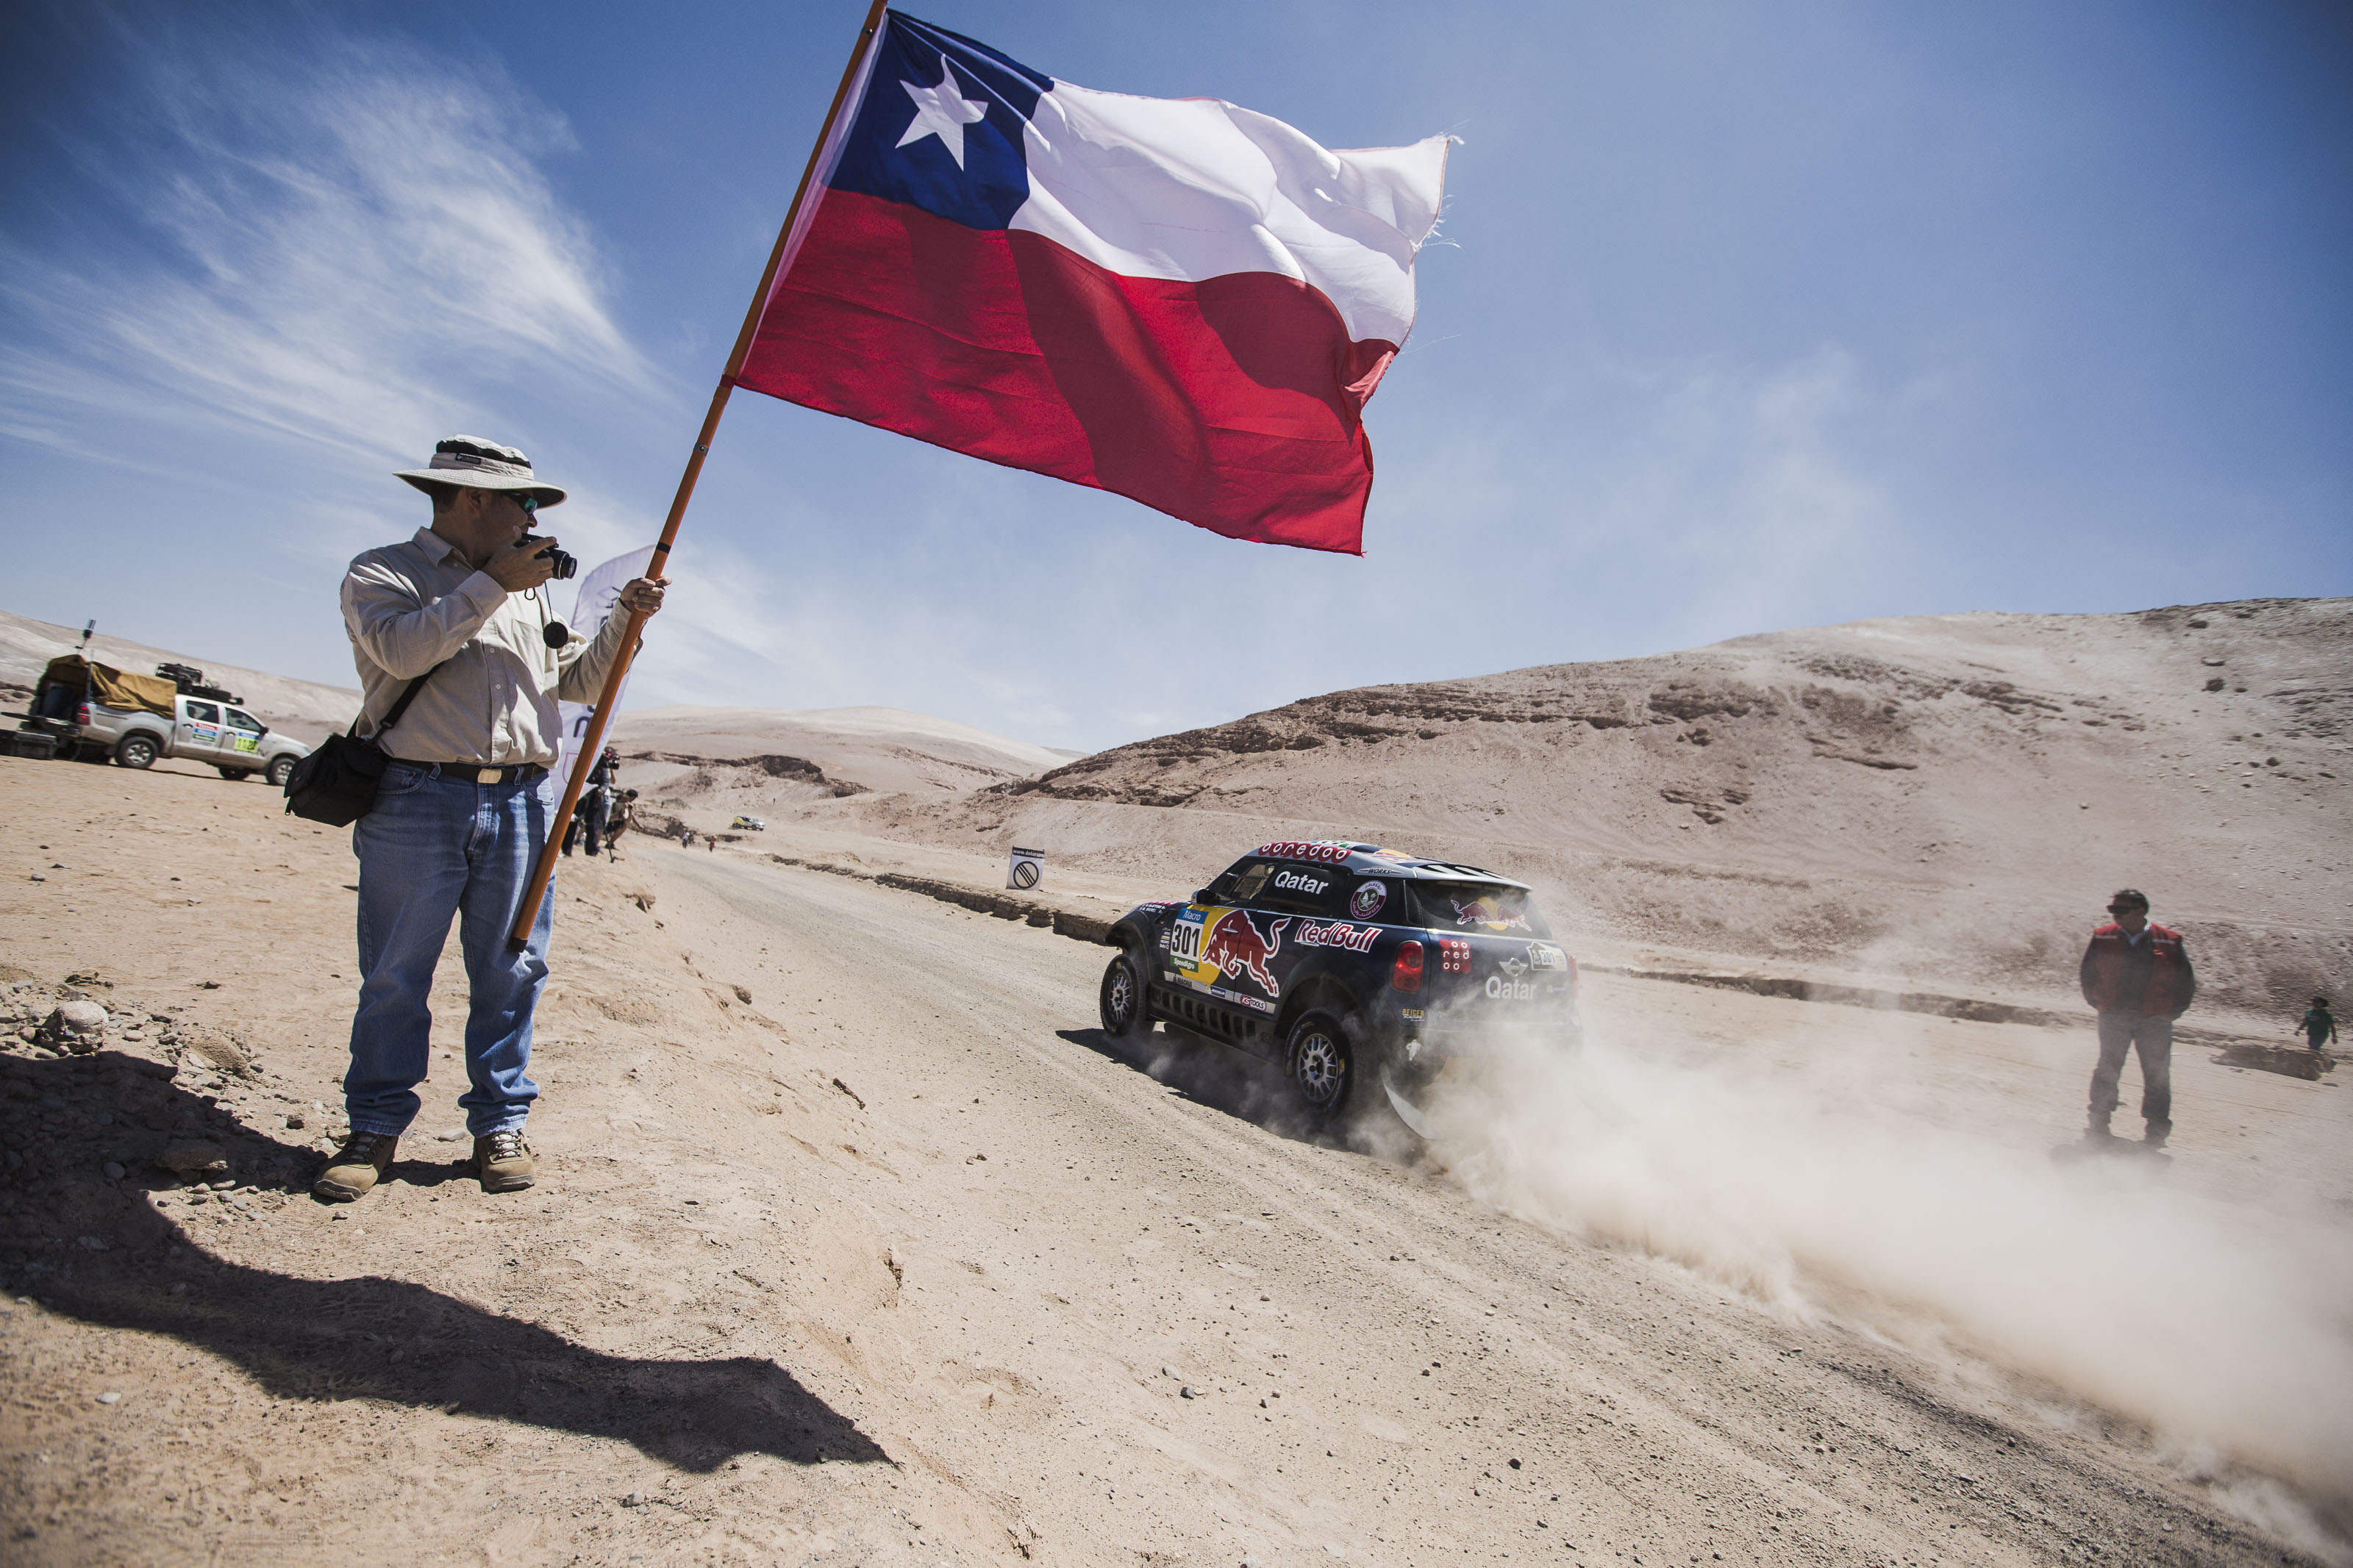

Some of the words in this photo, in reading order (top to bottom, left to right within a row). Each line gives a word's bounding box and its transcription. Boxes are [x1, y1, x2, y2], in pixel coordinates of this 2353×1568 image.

[1262, 842, 1347, 859] ooredoo
[1275, 871, 1329, 895] Qatar
[1182, 910, 1201, 920] Macro
[1172, 924, 1201, 957] 301
[1295, 919, 1341, 946] Red
[1329, 924, 1383, 953] Bull
[1443, 950, 1469, 959] red
[1485, 976, 1538, 1000] Qatar
[1242, 996, 1251, 1005] KS
[1250, 1000, 1265, 1009] TOOLS
